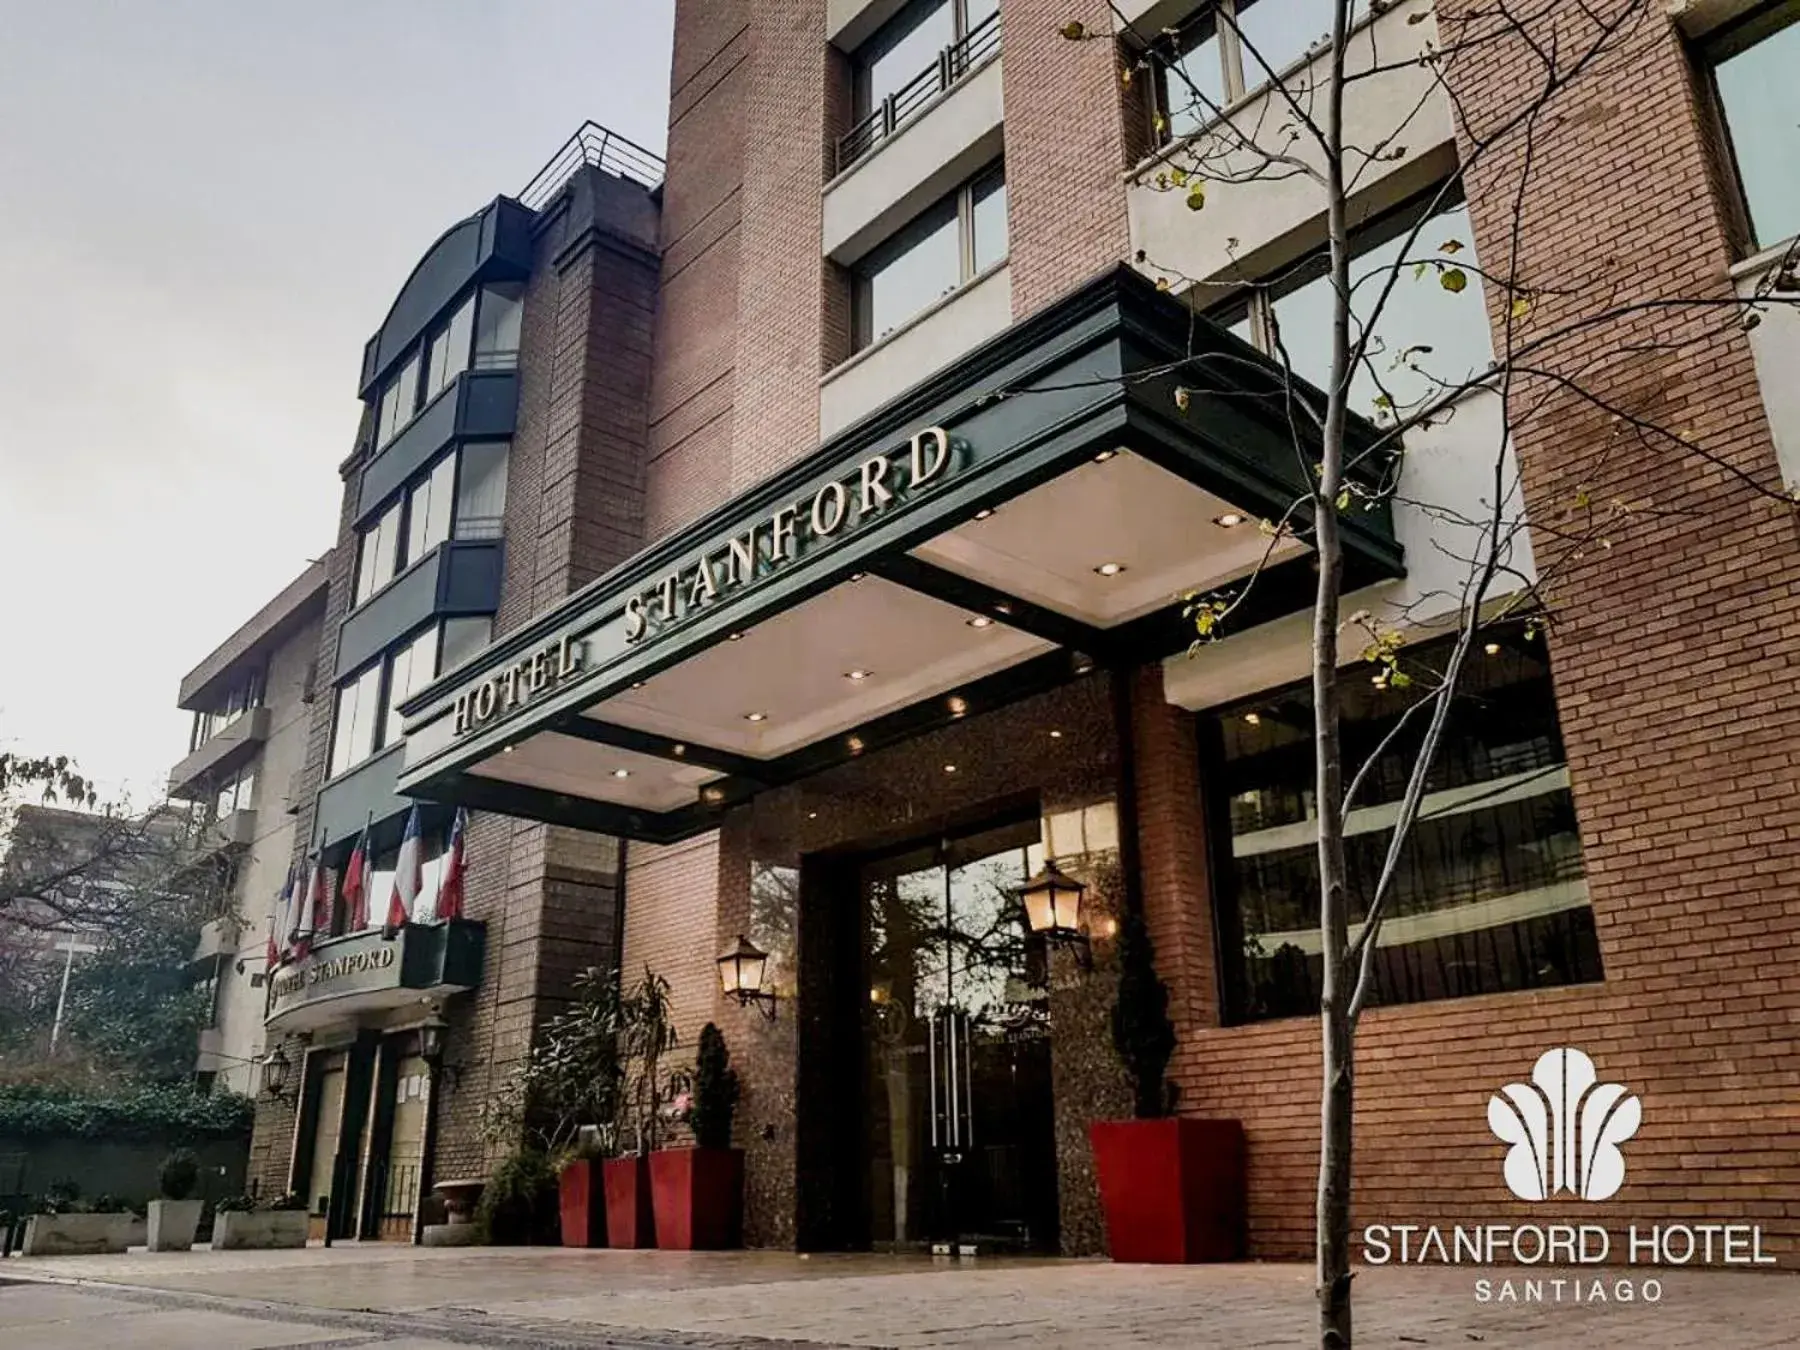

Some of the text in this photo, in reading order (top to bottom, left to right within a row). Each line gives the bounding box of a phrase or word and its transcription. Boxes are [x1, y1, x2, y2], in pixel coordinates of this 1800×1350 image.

[452, 426, 951, 737] HOTEL STANFORD
[310, 947, 394, 984] STANFORD
